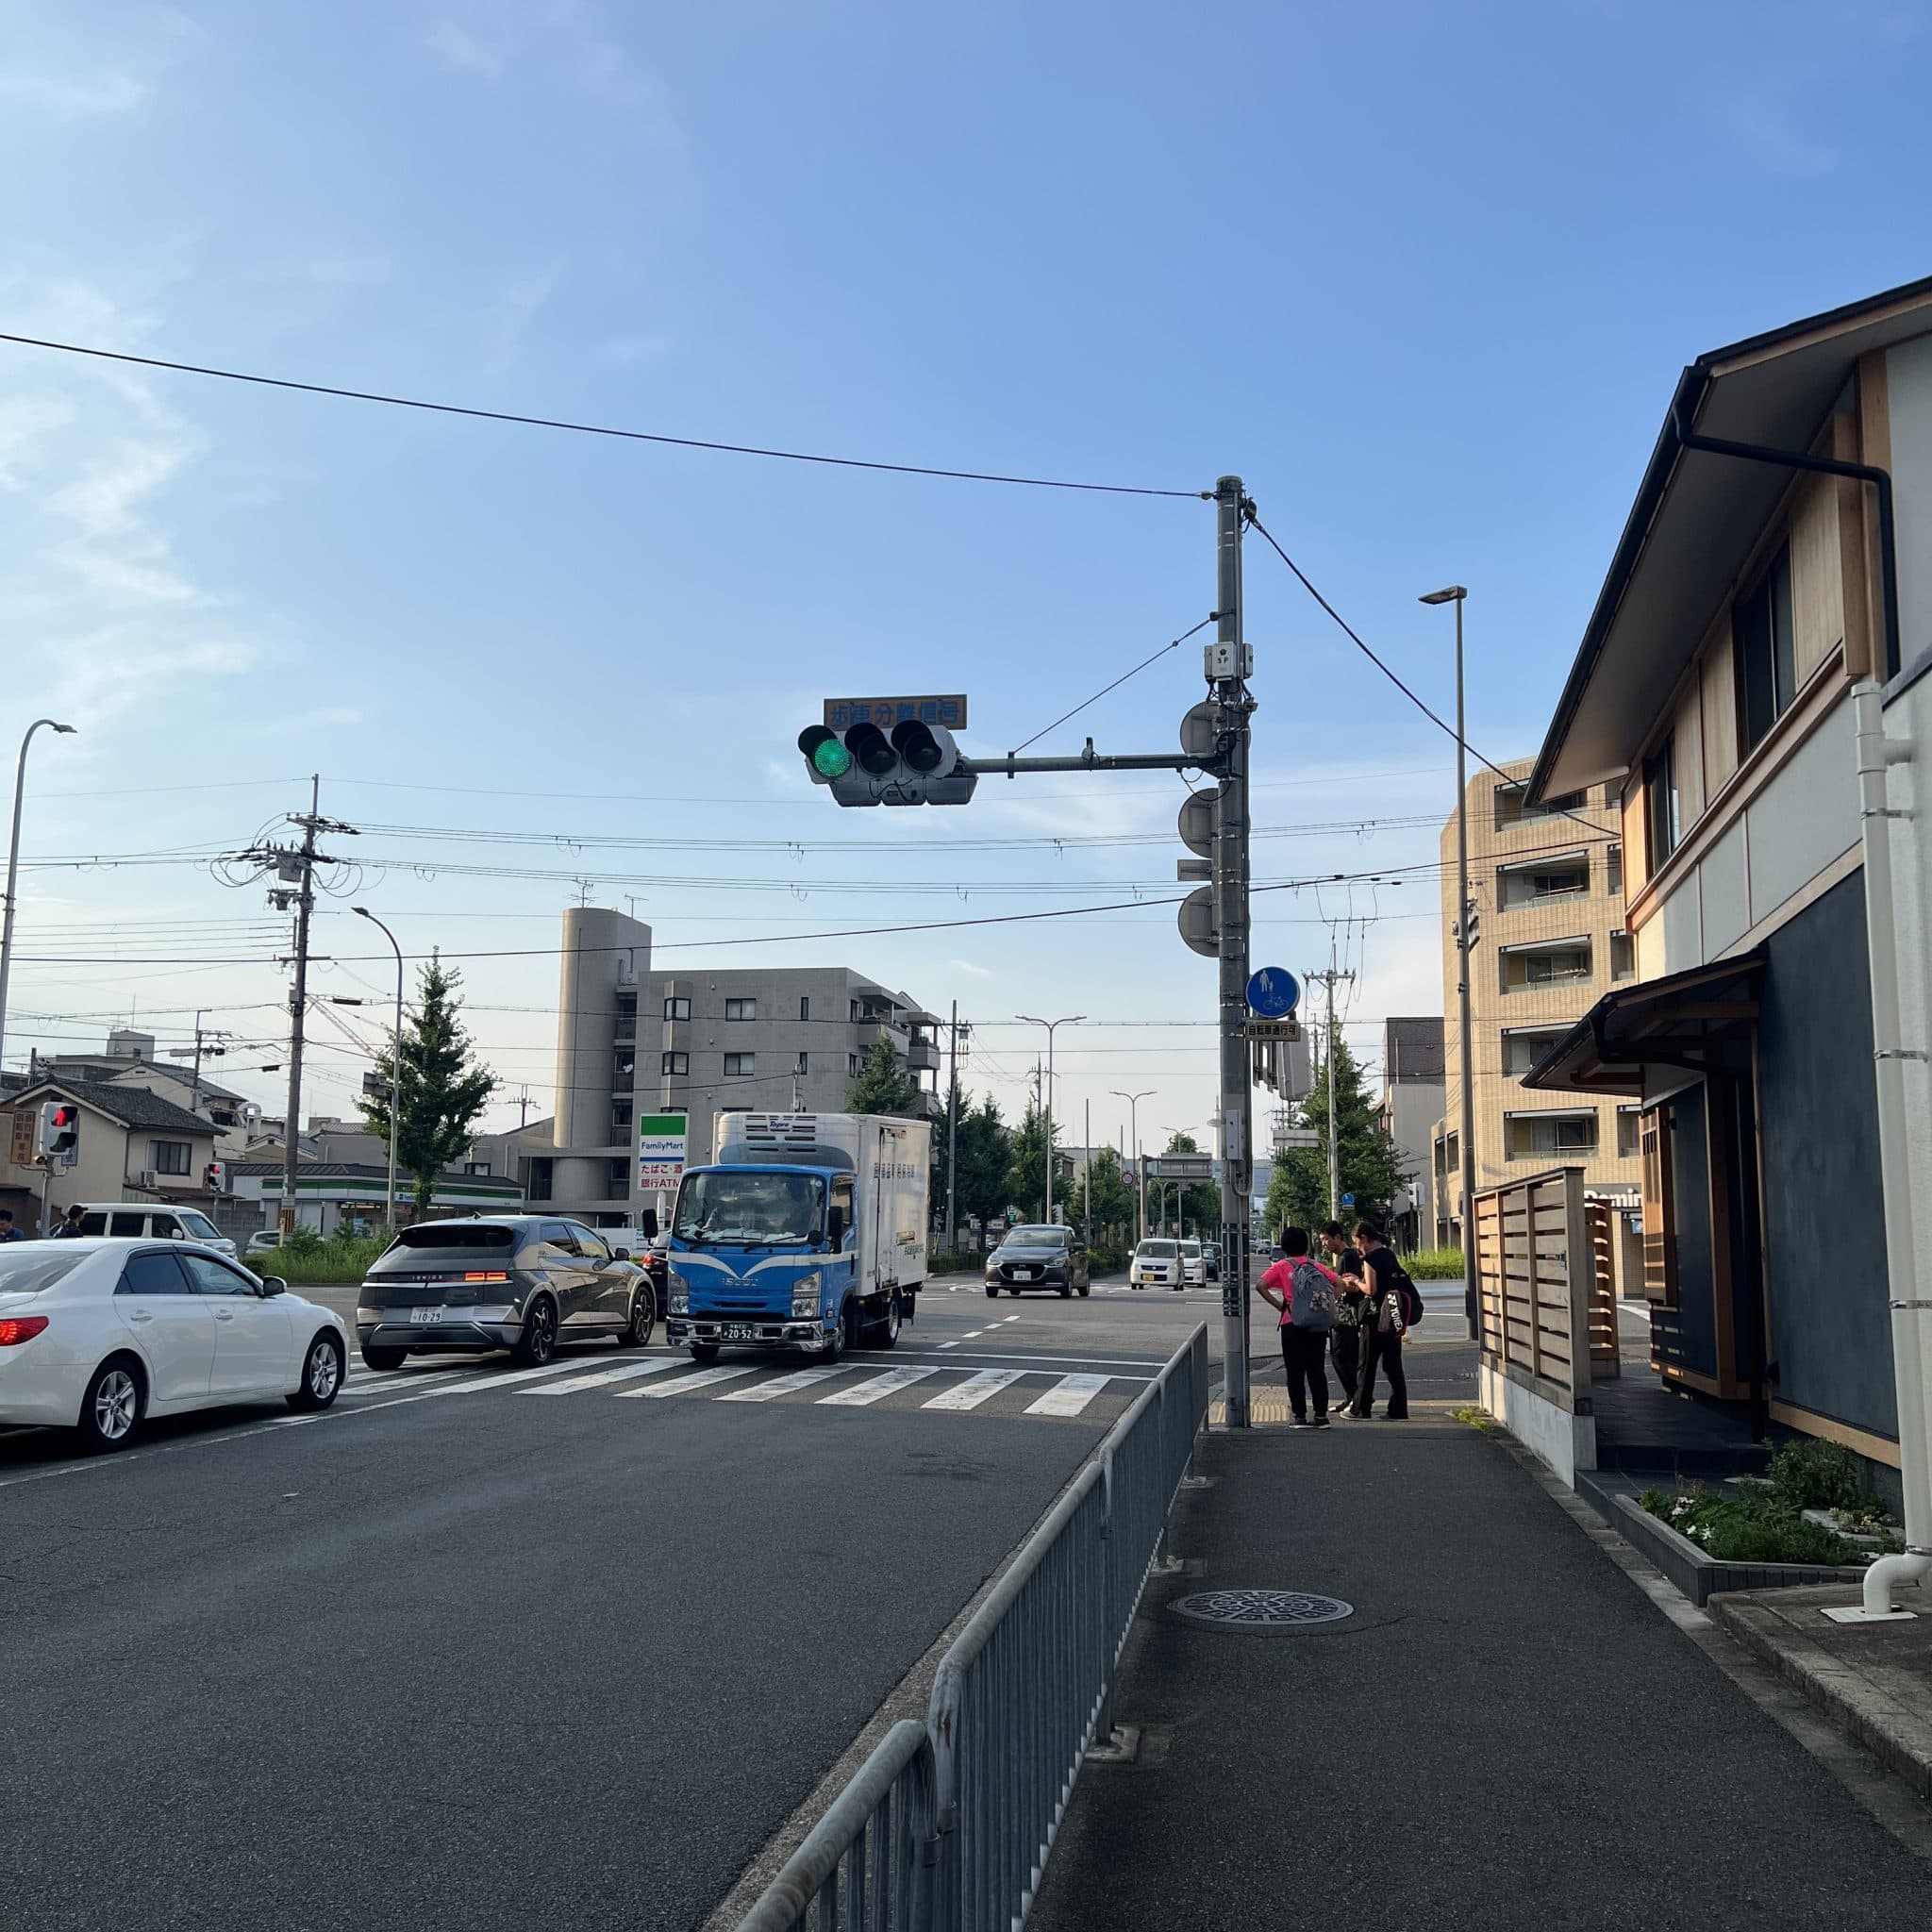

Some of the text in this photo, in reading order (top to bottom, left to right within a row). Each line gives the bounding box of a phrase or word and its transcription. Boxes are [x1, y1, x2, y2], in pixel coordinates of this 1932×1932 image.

[1248, 1024, 1297, 1036] 自転車通行可
[641, 1141, 684, 1152] FamilyMart
[641, 1163, 683, 1174] たばこ・酒
